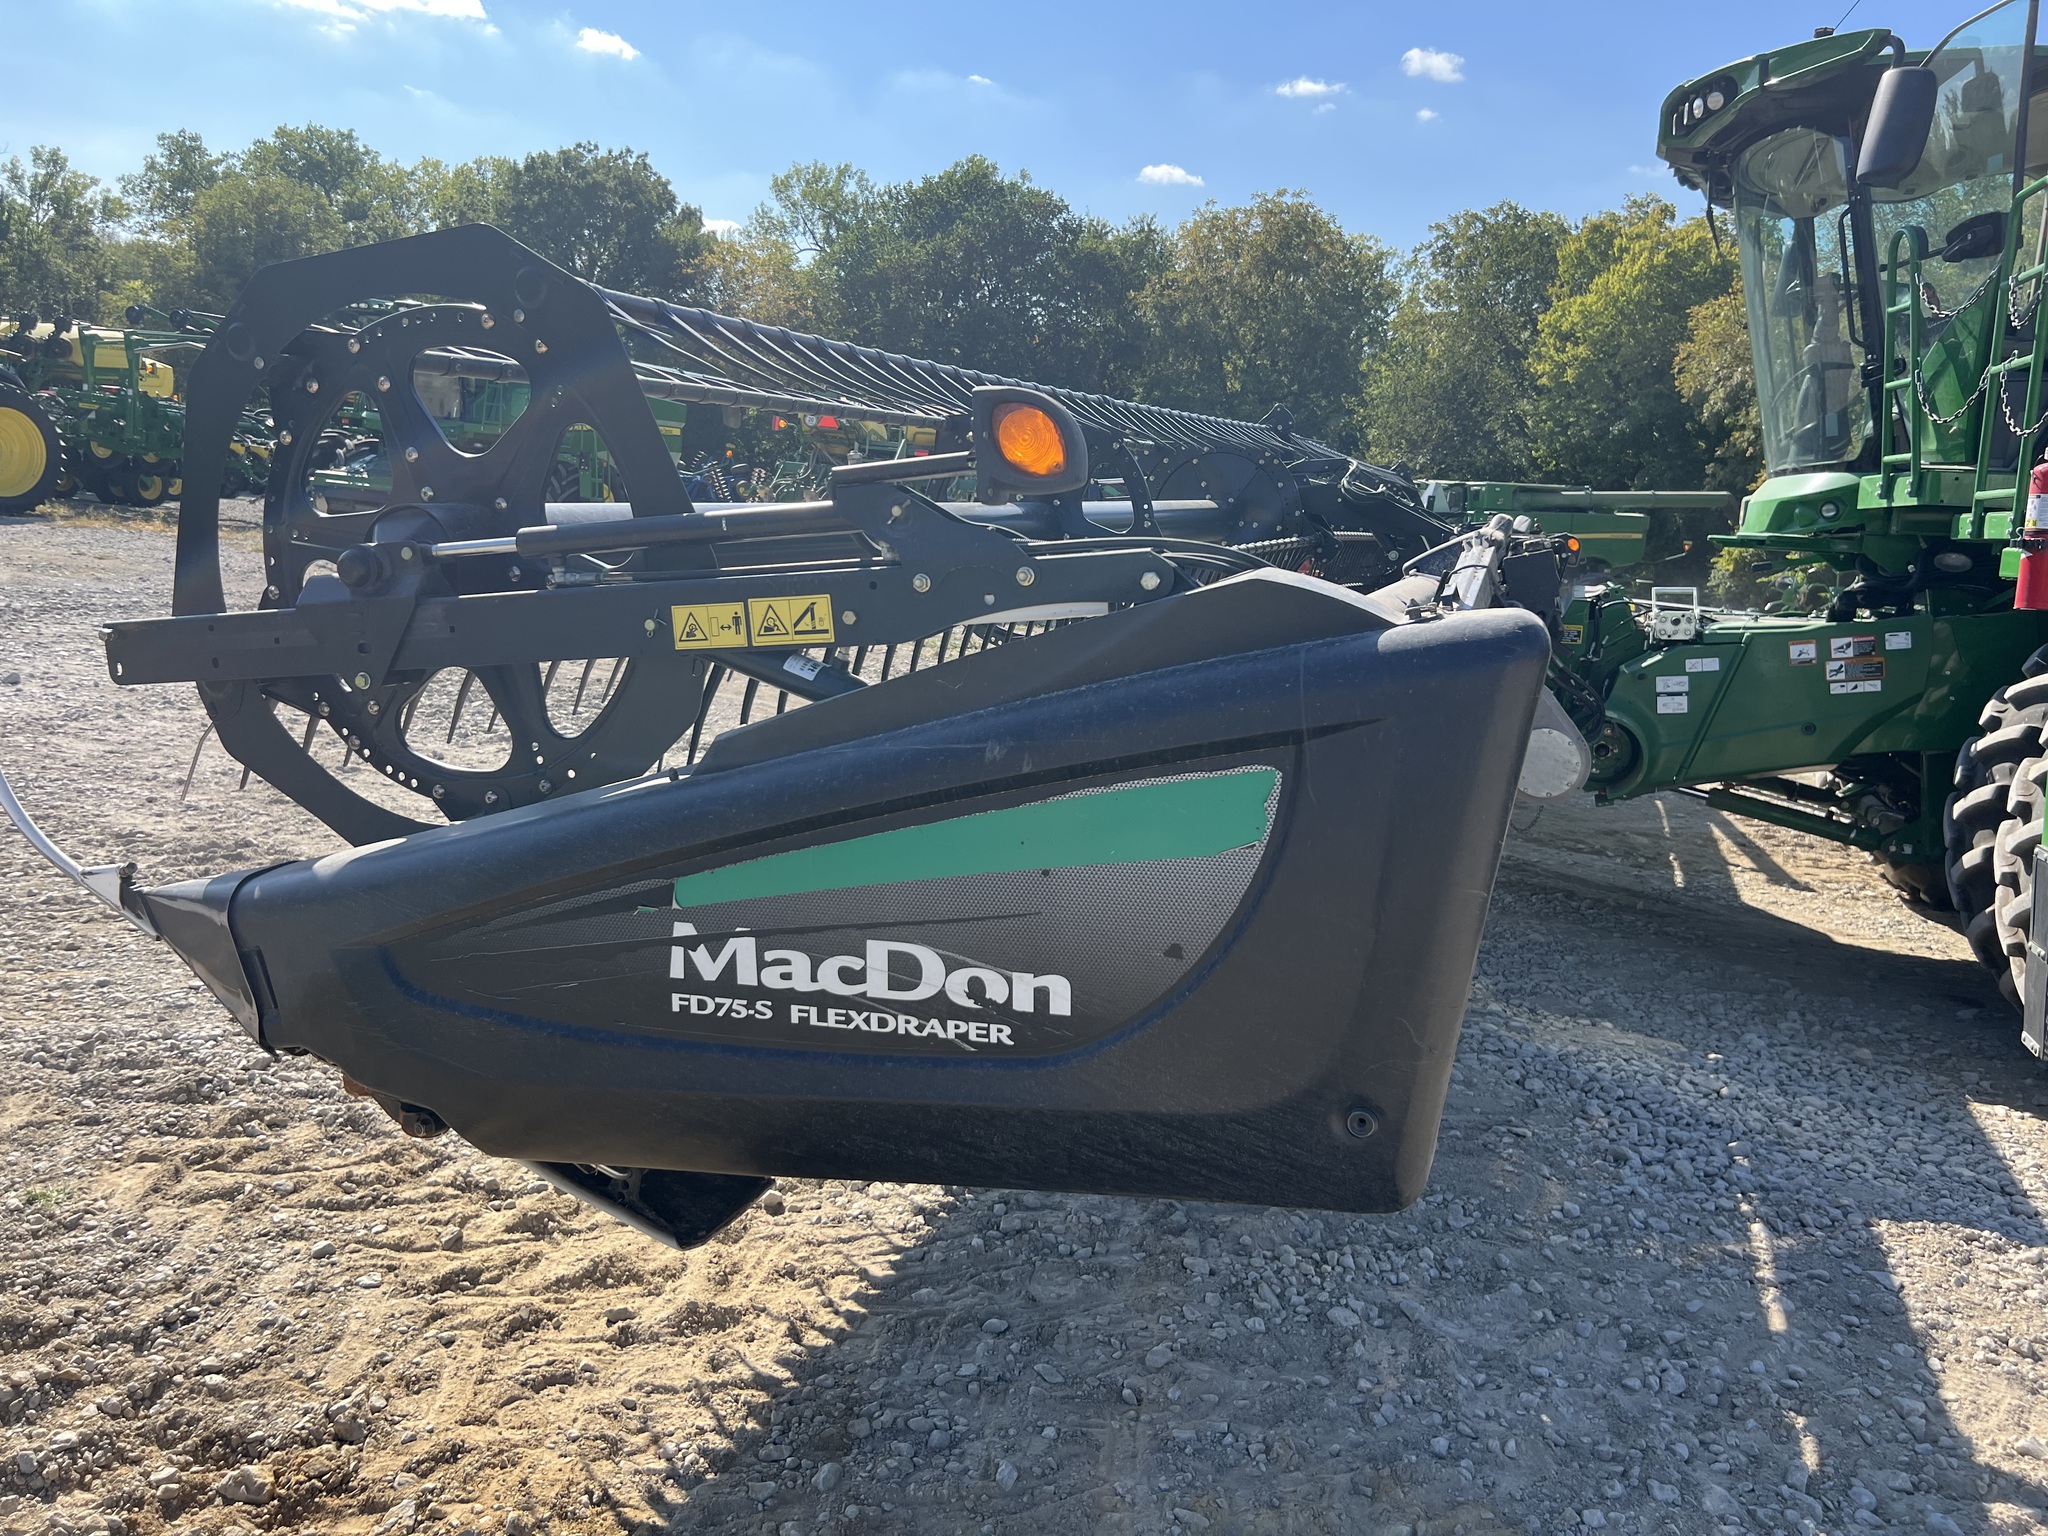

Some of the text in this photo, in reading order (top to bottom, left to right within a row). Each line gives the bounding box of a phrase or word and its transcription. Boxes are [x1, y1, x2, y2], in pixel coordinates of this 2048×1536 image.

[669, 921, 1072, 1016] MacDon
[671, 993, 1015, 1046] FD75-S FLEXDRAPER
